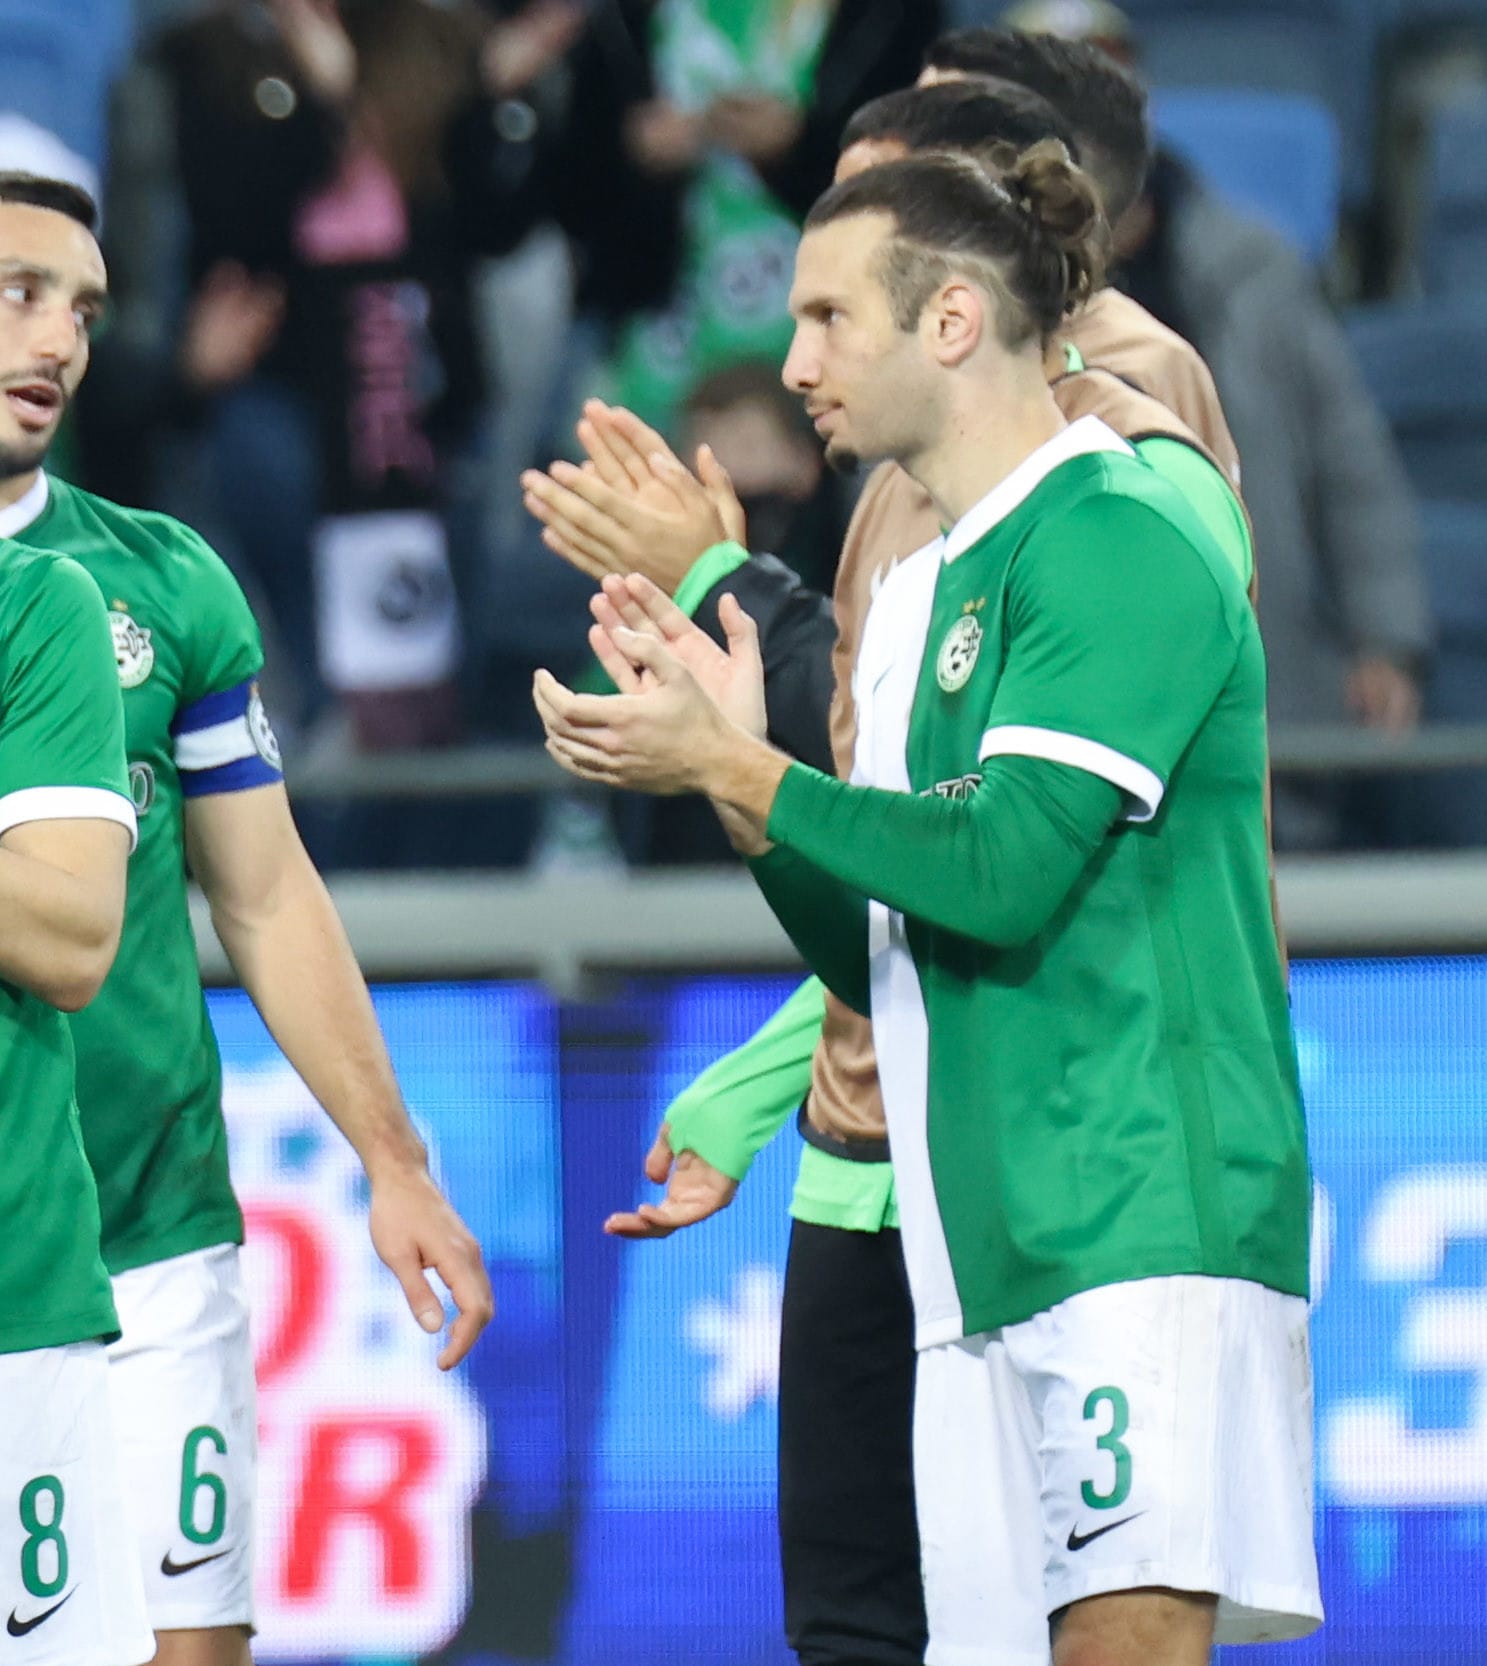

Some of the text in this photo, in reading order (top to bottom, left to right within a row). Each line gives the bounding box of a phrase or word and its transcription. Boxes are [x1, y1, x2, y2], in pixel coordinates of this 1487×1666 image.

[179, 1424, 227, 1546] 6
[1080, 1385, 1132, 1510] 3
[19, 1474, 69, 1598] 8
